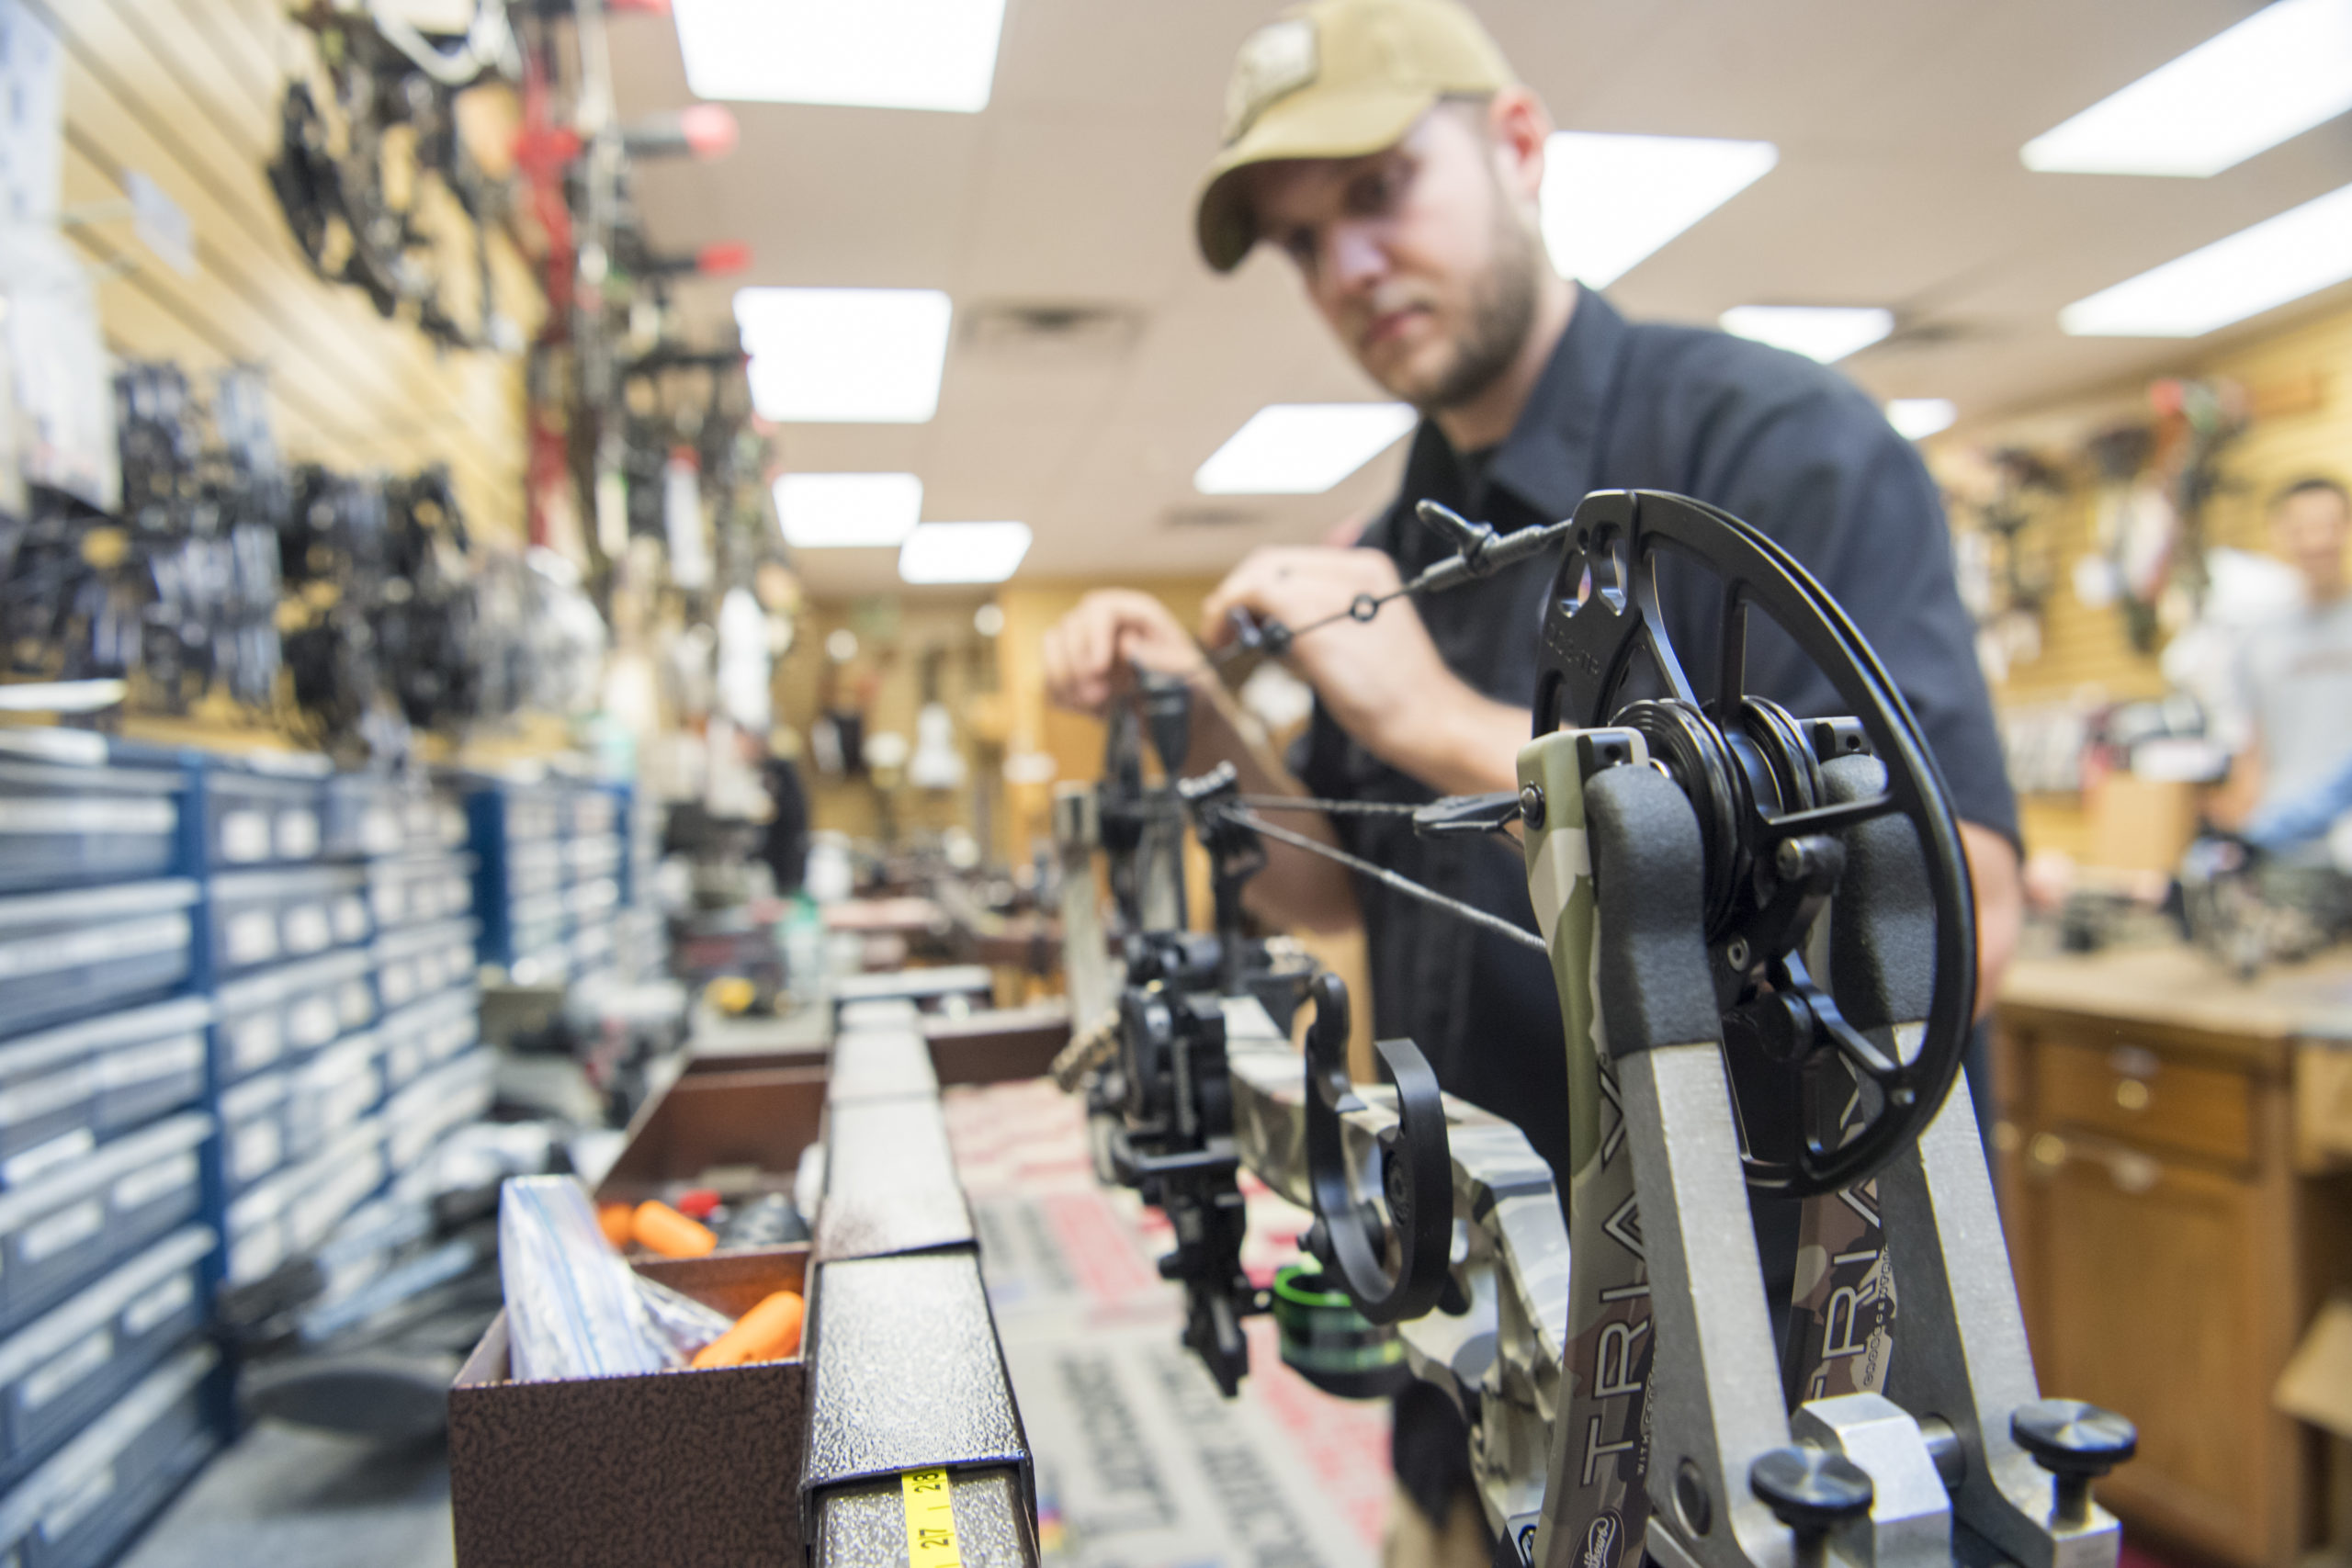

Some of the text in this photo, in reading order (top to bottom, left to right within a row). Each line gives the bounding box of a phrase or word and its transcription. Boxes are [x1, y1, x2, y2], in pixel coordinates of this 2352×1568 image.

[1636, 1435, 1649, 1476] WITH
[912, 1472, 940, 1494] 28
[919, 1529, 949, 1549] 27
